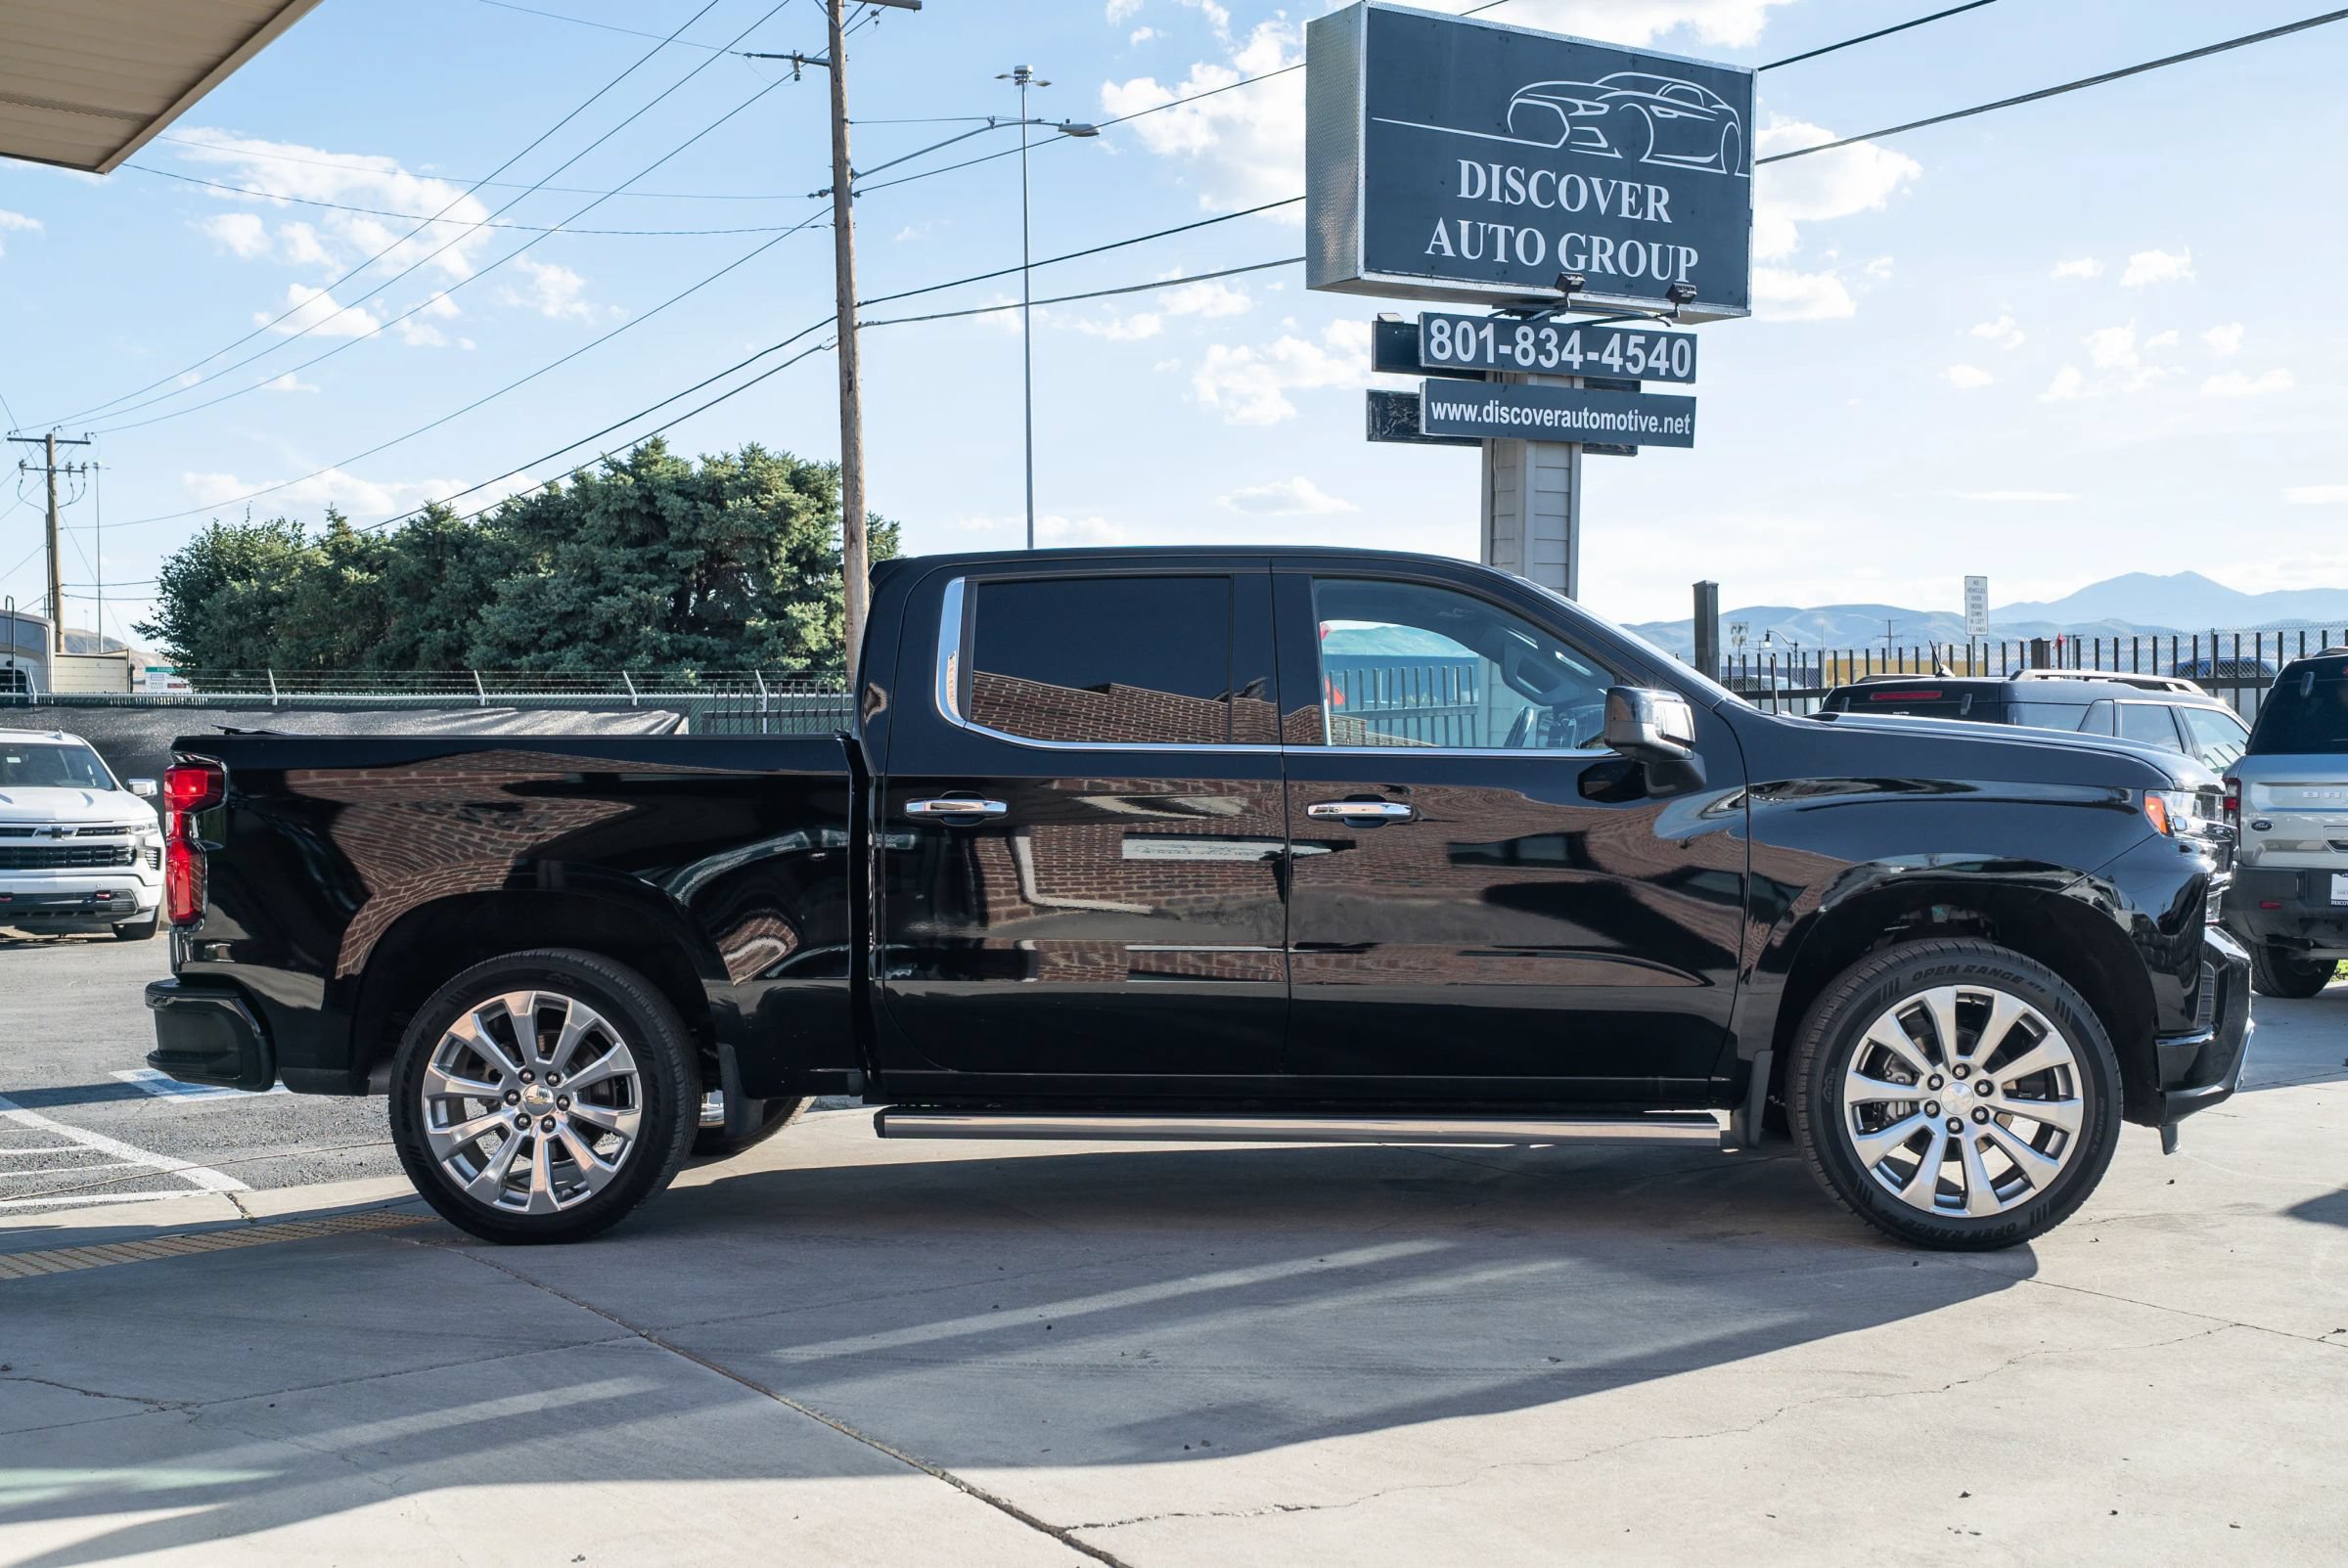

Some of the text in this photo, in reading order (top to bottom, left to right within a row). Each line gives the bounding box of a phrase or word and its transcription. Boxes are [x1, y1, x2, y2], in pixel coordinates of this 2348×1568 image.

[1457, 158, 1673, 224] DISCOVER
[1424, 216, 1698, 283] AUTO GROUP
[1429, 319, 1692, 378] 801-834-4540
[1430, 399, 1691, 434] www.discoverautomotive.net
[1912, 964, 1960, 982] OPEN
[1963, 963, 2024, 984] RANGE
